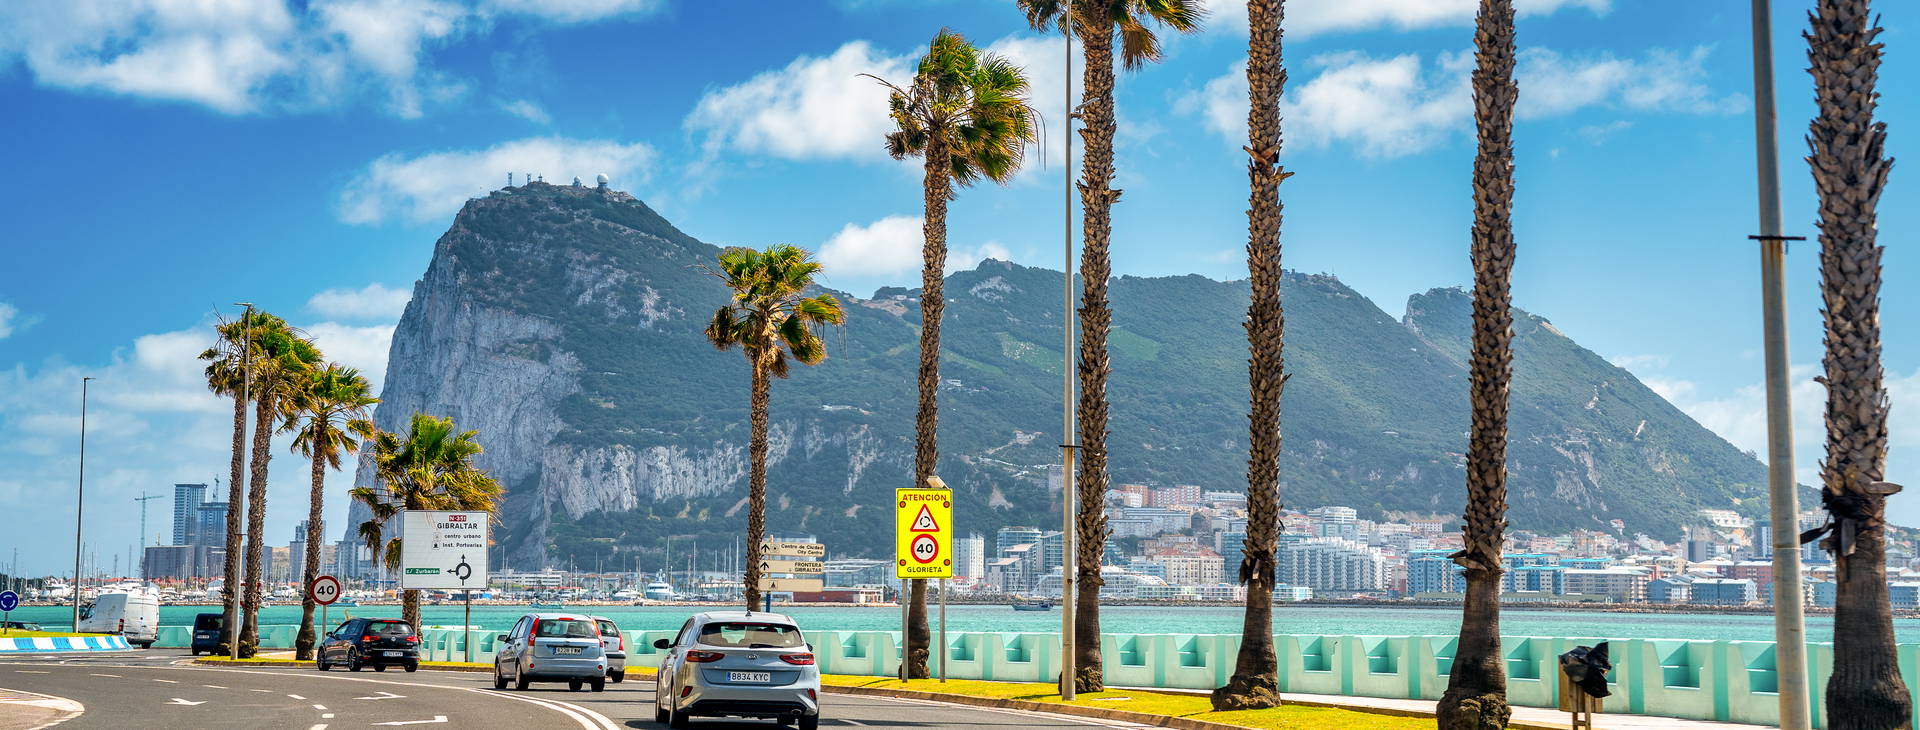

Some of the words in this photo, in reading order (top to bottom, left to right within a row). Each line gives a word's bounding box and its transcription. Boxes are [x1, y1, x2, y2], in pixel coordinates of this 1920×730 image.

[902, 492, 947, 501] ATENCIÓN
[916, 544, 933, 553] 40
[316, 585, 335, 595] 40
[731, 672, 751, 681] 8834
[753, 673, 769, 681] KYC
